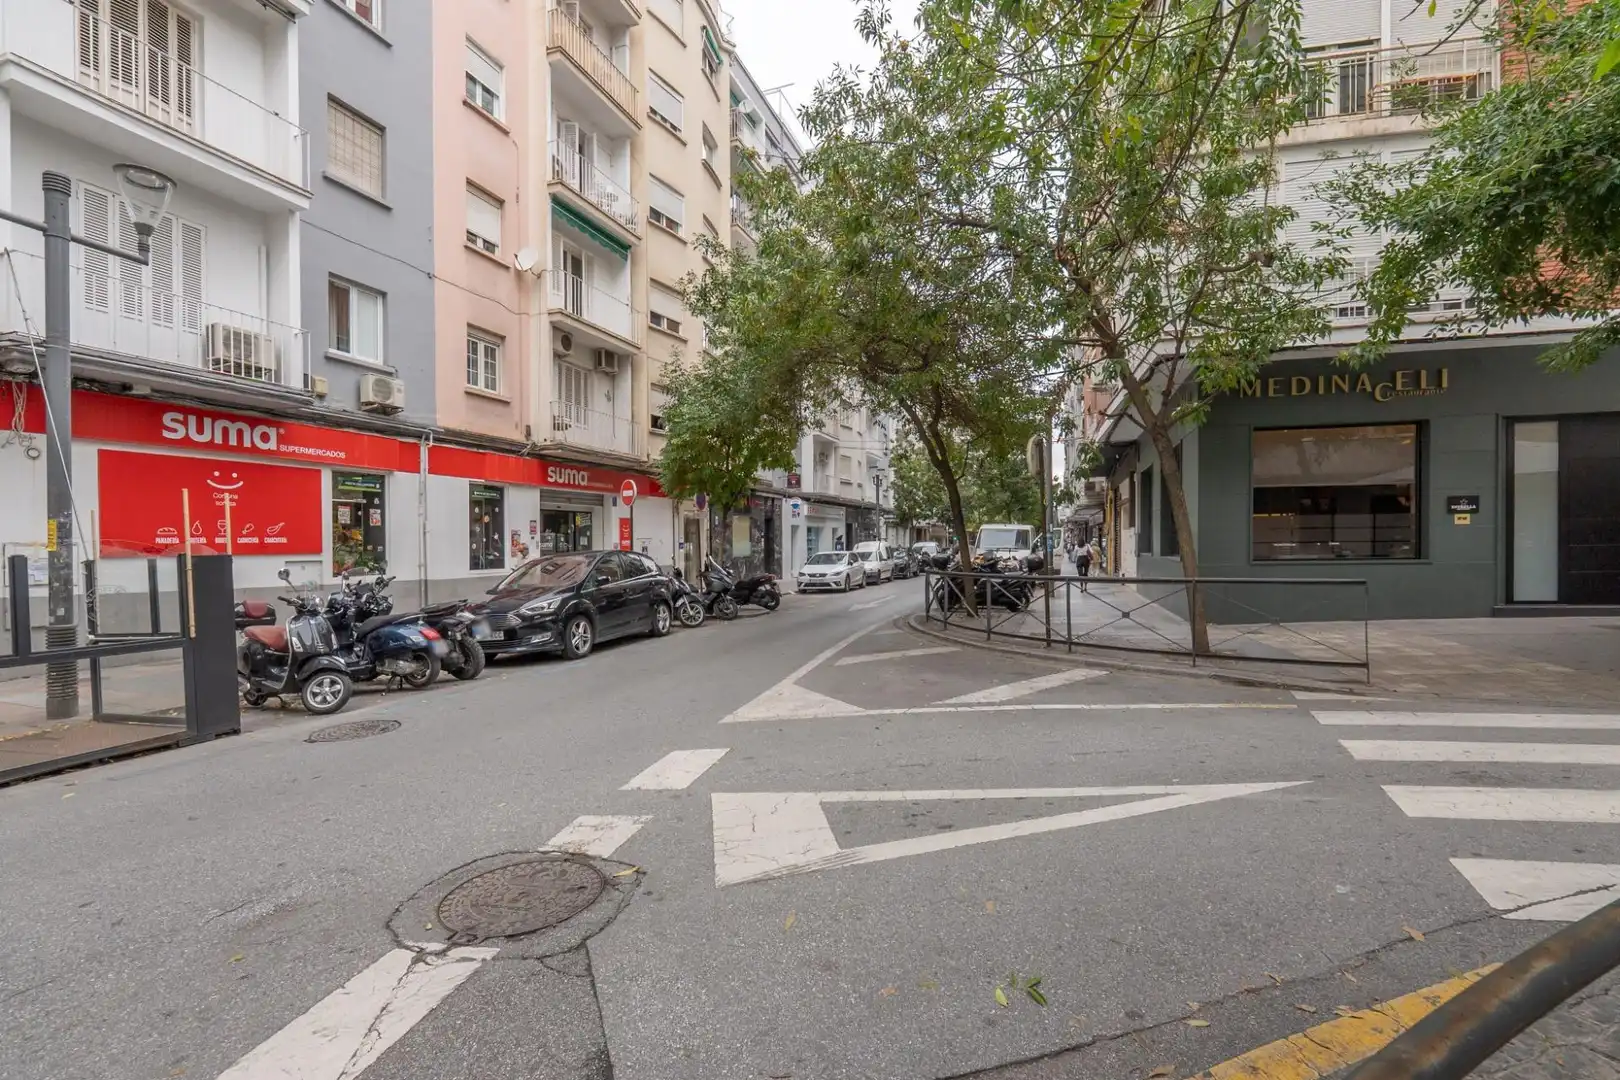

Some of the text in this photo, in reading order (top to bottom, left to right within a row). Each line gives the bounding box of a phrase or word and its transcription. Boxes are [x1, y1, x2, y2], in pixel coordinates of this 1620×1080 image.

[162, 411, 278, 451] suma
[279, 444, 346, 459] SUPERMERCADOS
[547, 466, 588, 486] suma
